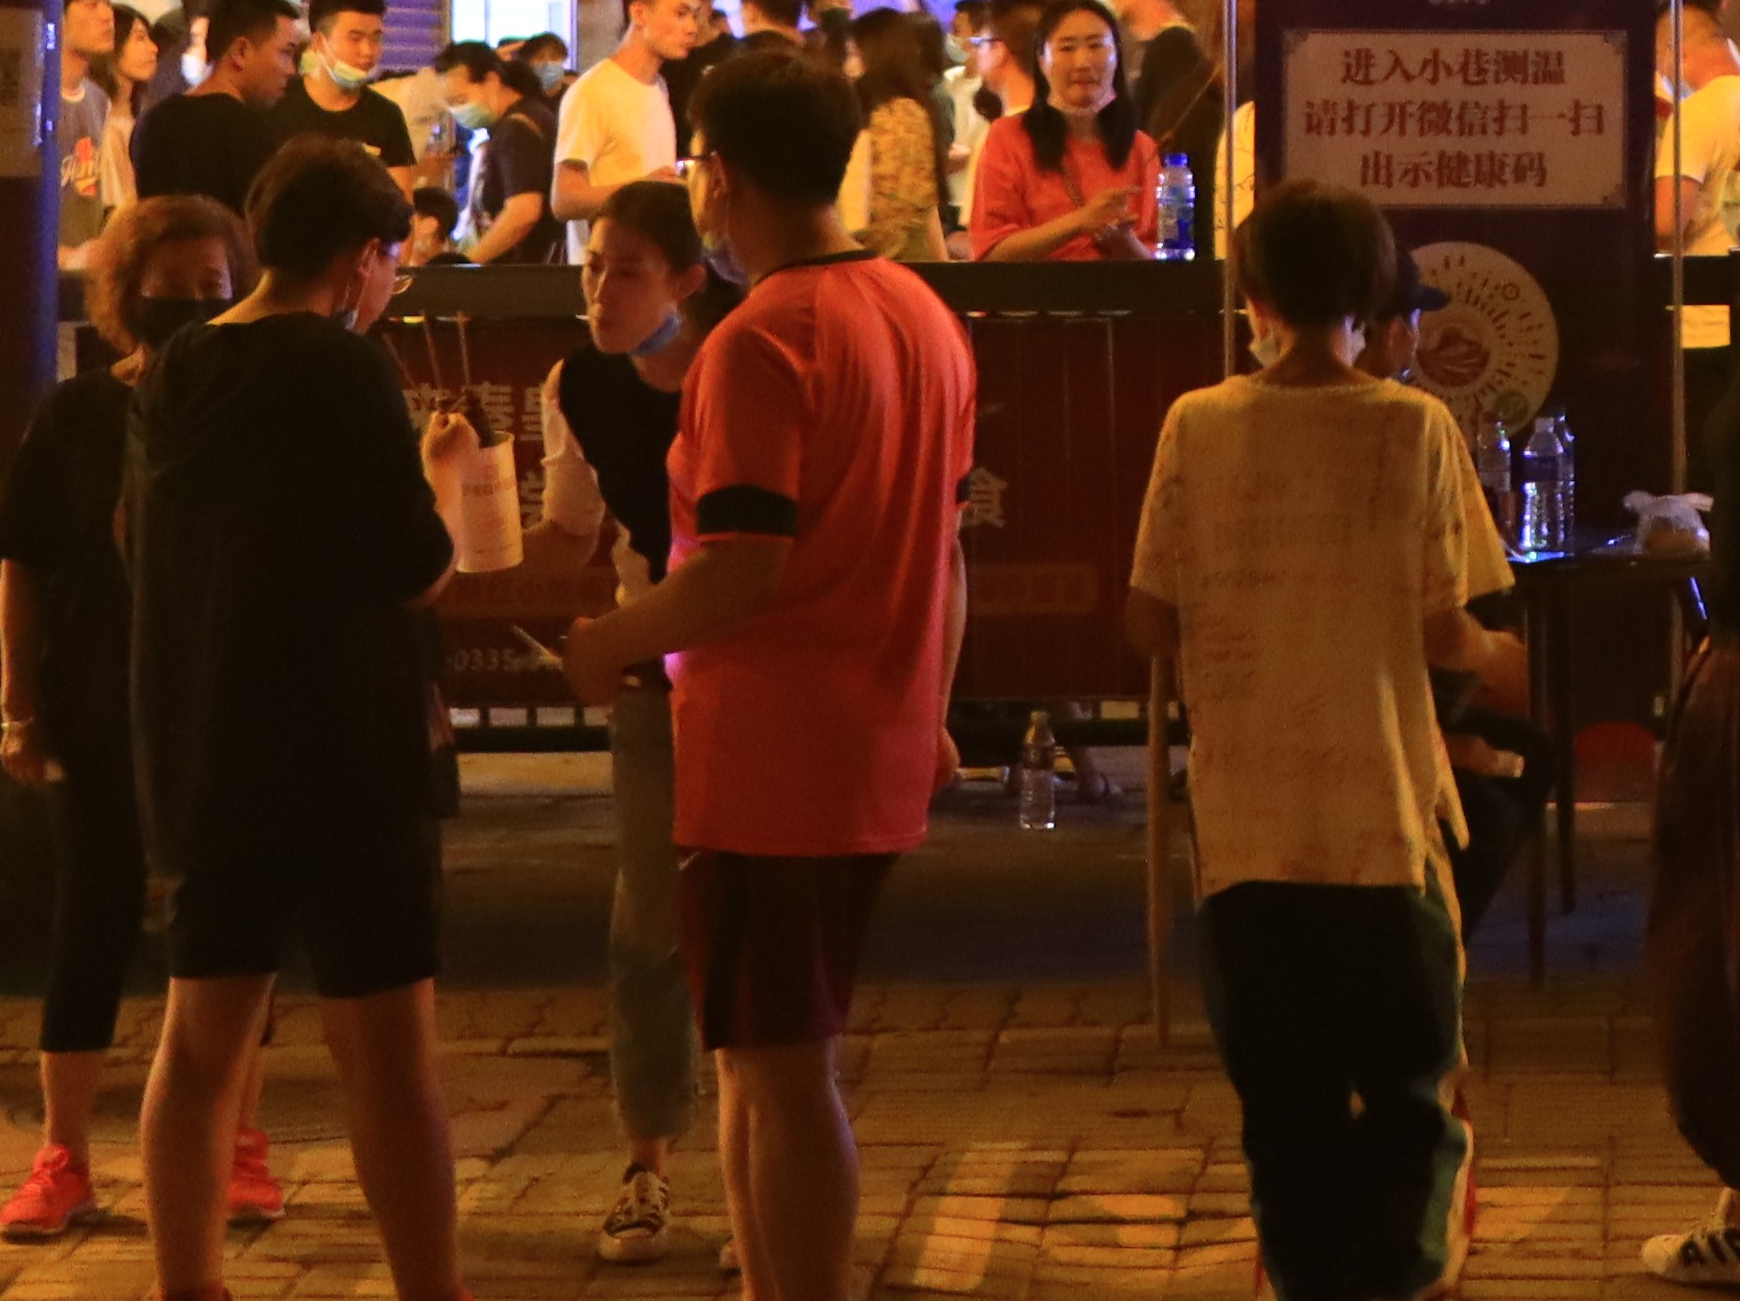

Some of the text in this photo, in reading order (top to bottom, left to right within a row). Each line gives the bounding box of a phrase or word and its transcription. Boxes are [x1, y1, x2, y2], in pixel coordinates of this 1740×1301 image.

[1340, 46, 1567, 87] 进入小巷测温
[1302, 97, 1606, 139] 请打开微信扫一扫
[1360, 149, 1549, 190] 出示健康码
